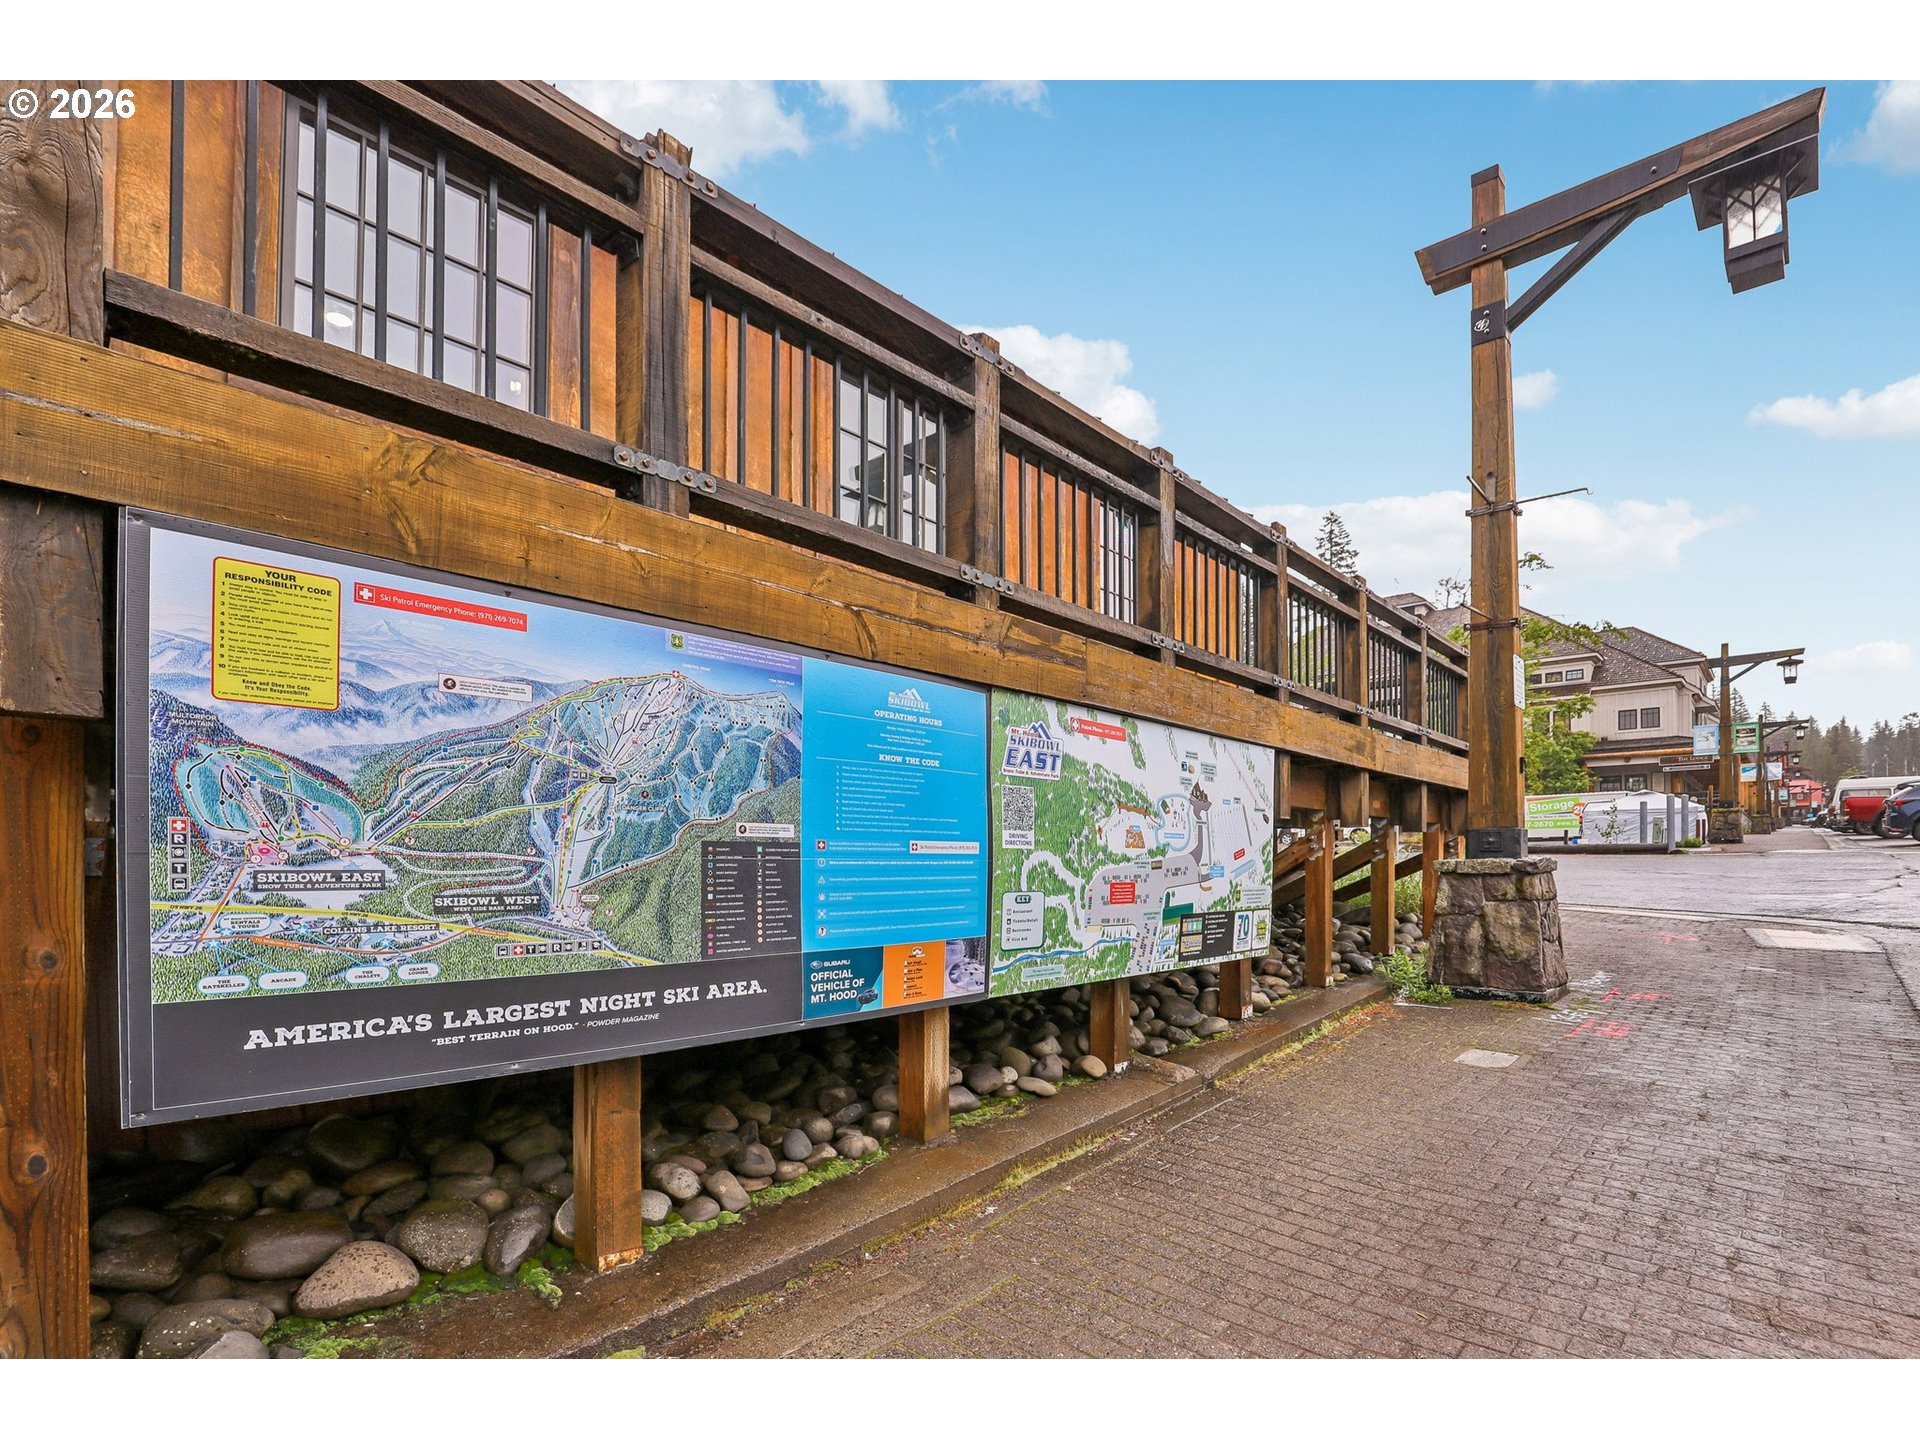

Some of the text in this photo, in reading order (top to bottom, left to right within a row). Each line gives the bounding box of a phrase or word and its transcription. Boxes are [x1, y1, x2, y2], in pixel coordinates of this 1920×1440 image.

[265, 570, 296, 582] YOUR
[225, 572, 304, 591] RESPONSIBILITY
[307, 587, 332, 596] CODE
[393, 596, 413, 606] Patrol
[415, 601, 452, 613] Emergency
[478, 612, 492, 620] (971)
[494, 614, 523, 625] 269-7074
[270, 687, 310, 697] Responsibility.
[168, 712, 216, 721] MULTORPOR
[874, 710, 942, 726] OPERATING HOURS
[1010, 735, 1061, 751] SKIBOWL
[1006, 747, 1060, 771] EAST
[245, 792, 262, 816] CASCADE
[1530, 801, 1574, 812] Storage
[256, 872, 382, 882] SKIBOWL EAST
[435, 896, 540, 907] SKIBOWL WEST
[811, 969, 853, 982] OFFICIAL
[811, 978, 864, 993] VEHICLE OF
[811, 990, 857, 1004] MT. HOOD
[244, 979, 768, 1050] AMERICA'S LARGEST NIGHT SKI AREA.
[432, 1035, 466, 1046] "BEST
[469, 1028, 520, 1042] TERRAIN
[524, 1026, 539, 1035] ON
[587, 1018, 620, 1028] POWDER
[622, 1012, 660, 1024] MAGAZINE
